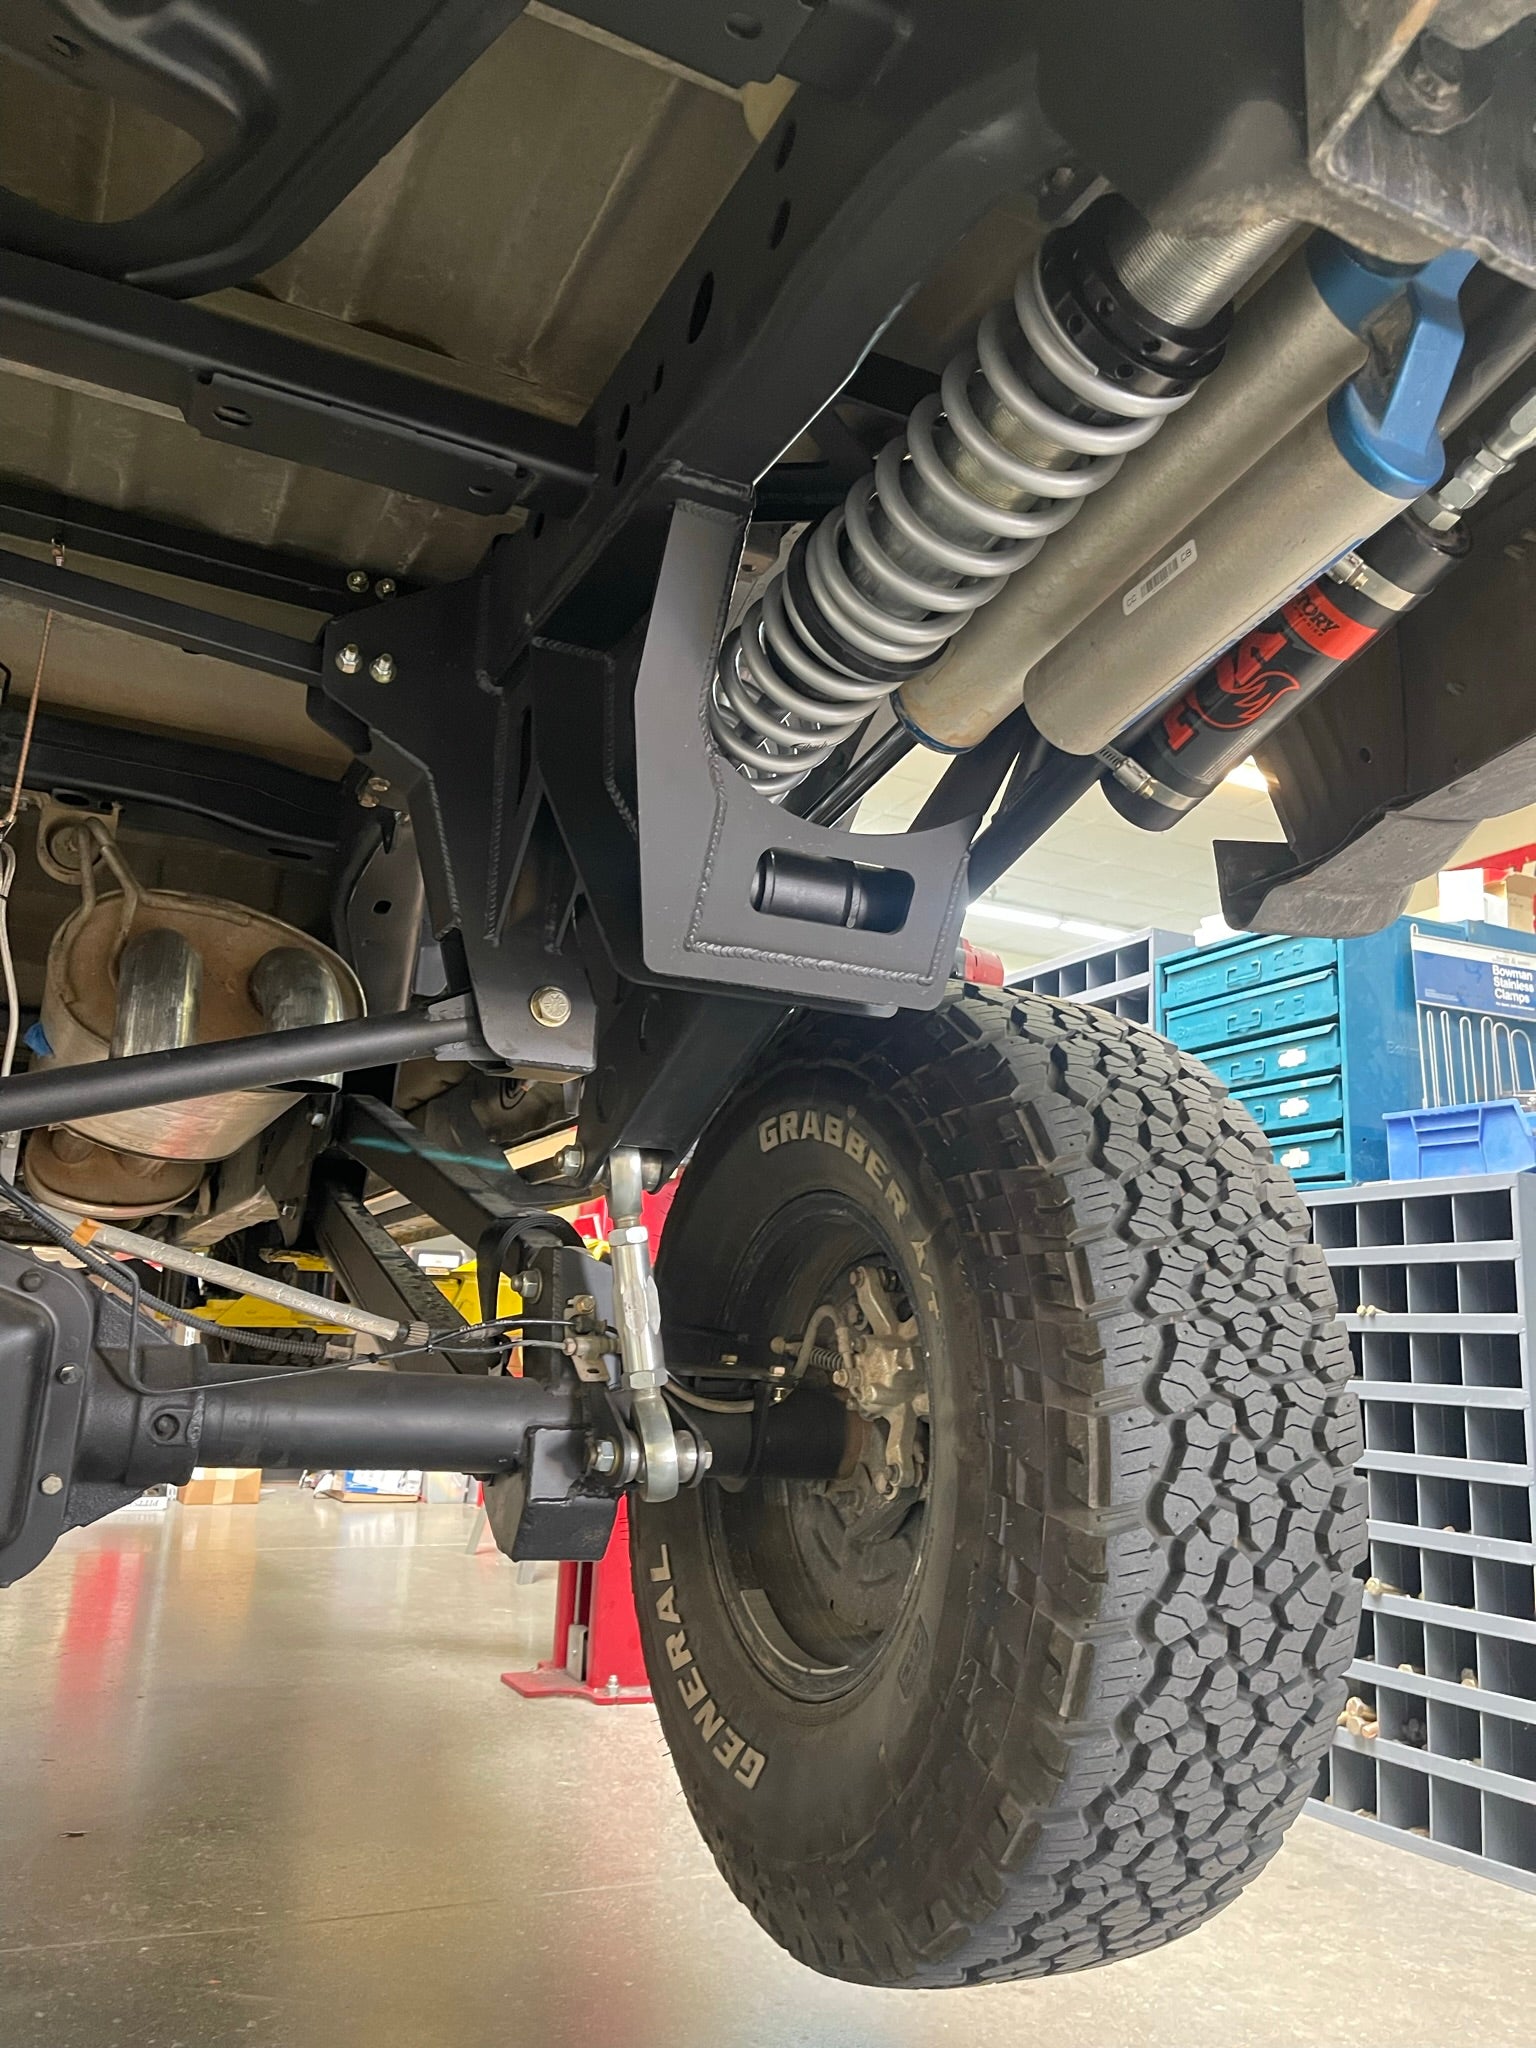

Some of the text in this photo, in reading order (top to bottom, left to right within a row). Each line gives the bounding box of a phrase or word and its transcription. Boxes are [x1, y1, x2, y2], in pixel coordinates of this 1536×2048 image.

[1492, 963, 1533, 980] Bowman
[1494, 976, 1535, 993] Stainless
[1495, 988, 1530, 1004] Clamps
[758, 1109, 910, 1223] GRABBER
[650, 1544, 767, 1791] GENERAL
